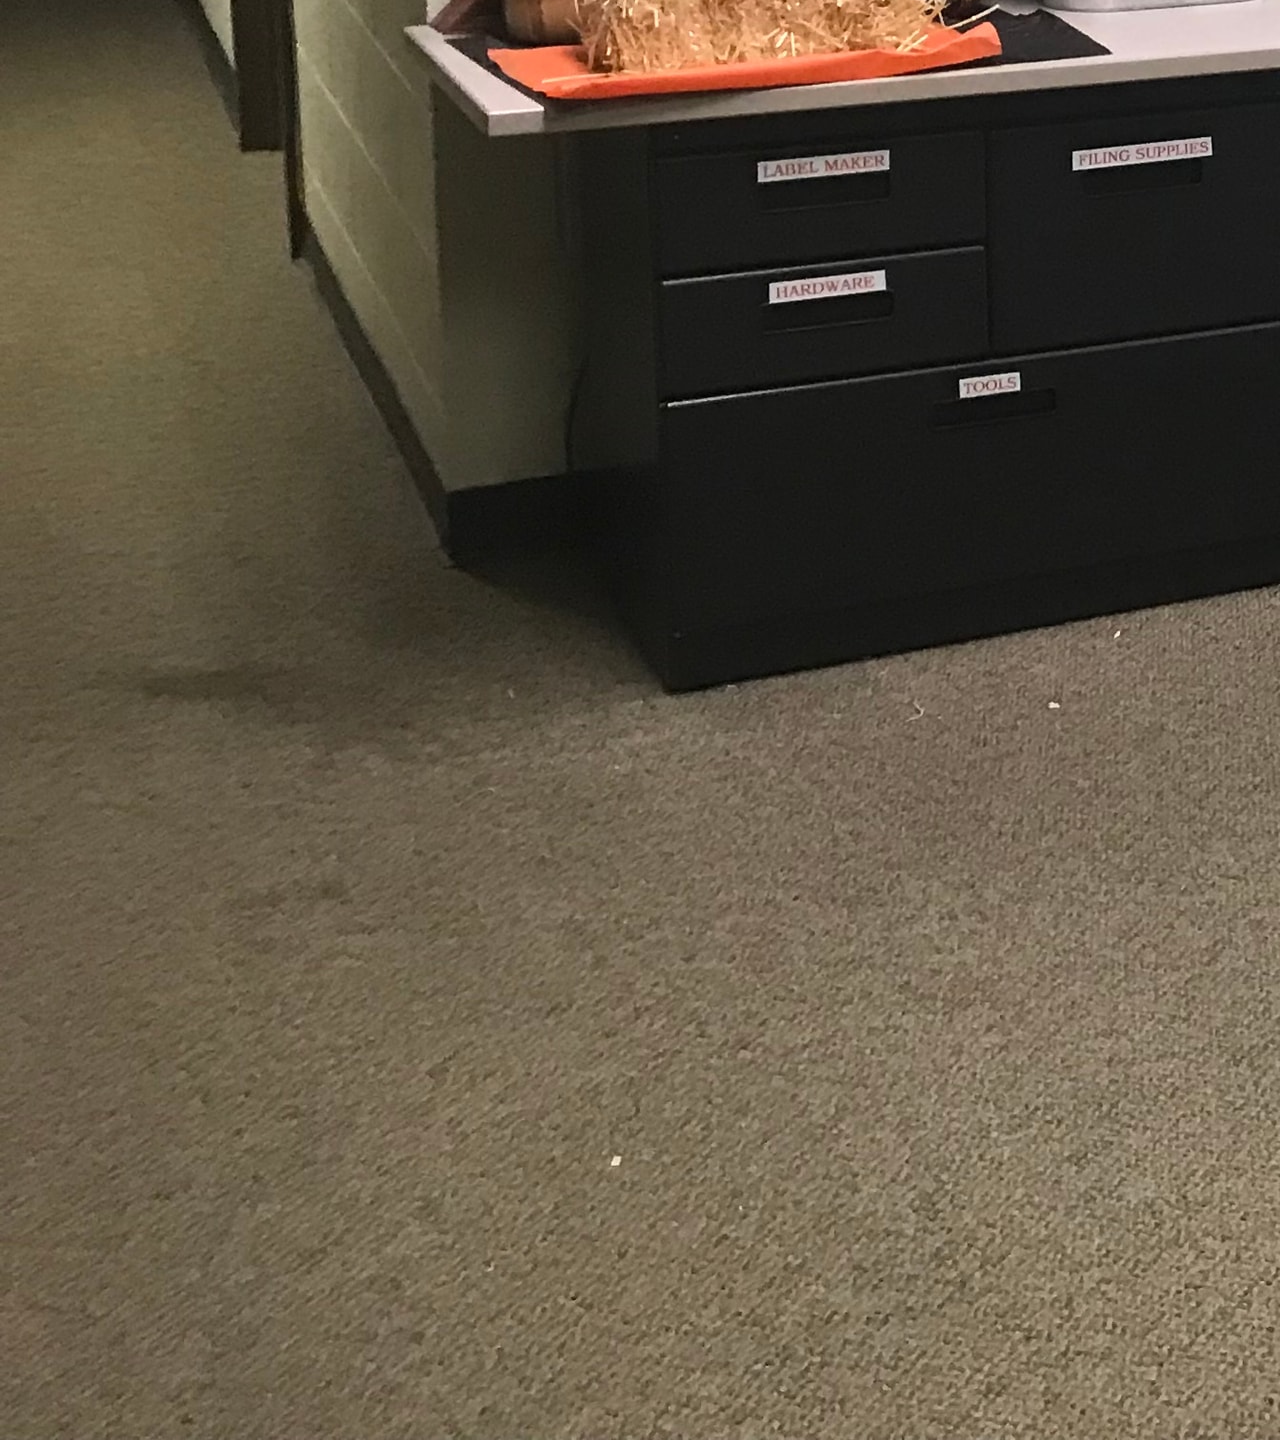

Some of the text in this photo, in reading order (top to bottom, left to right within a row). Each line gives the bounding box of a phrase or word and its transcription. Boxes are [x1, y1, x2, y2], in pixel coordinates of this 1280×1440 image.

[1078, 140, 1210, 167] FILING SUPPLIES
[763, 154, 886, 179] LABEL MAKER
[775, 275, 876, 299] HARDWARE
[963, 376, 1017, 395] TOOLS
